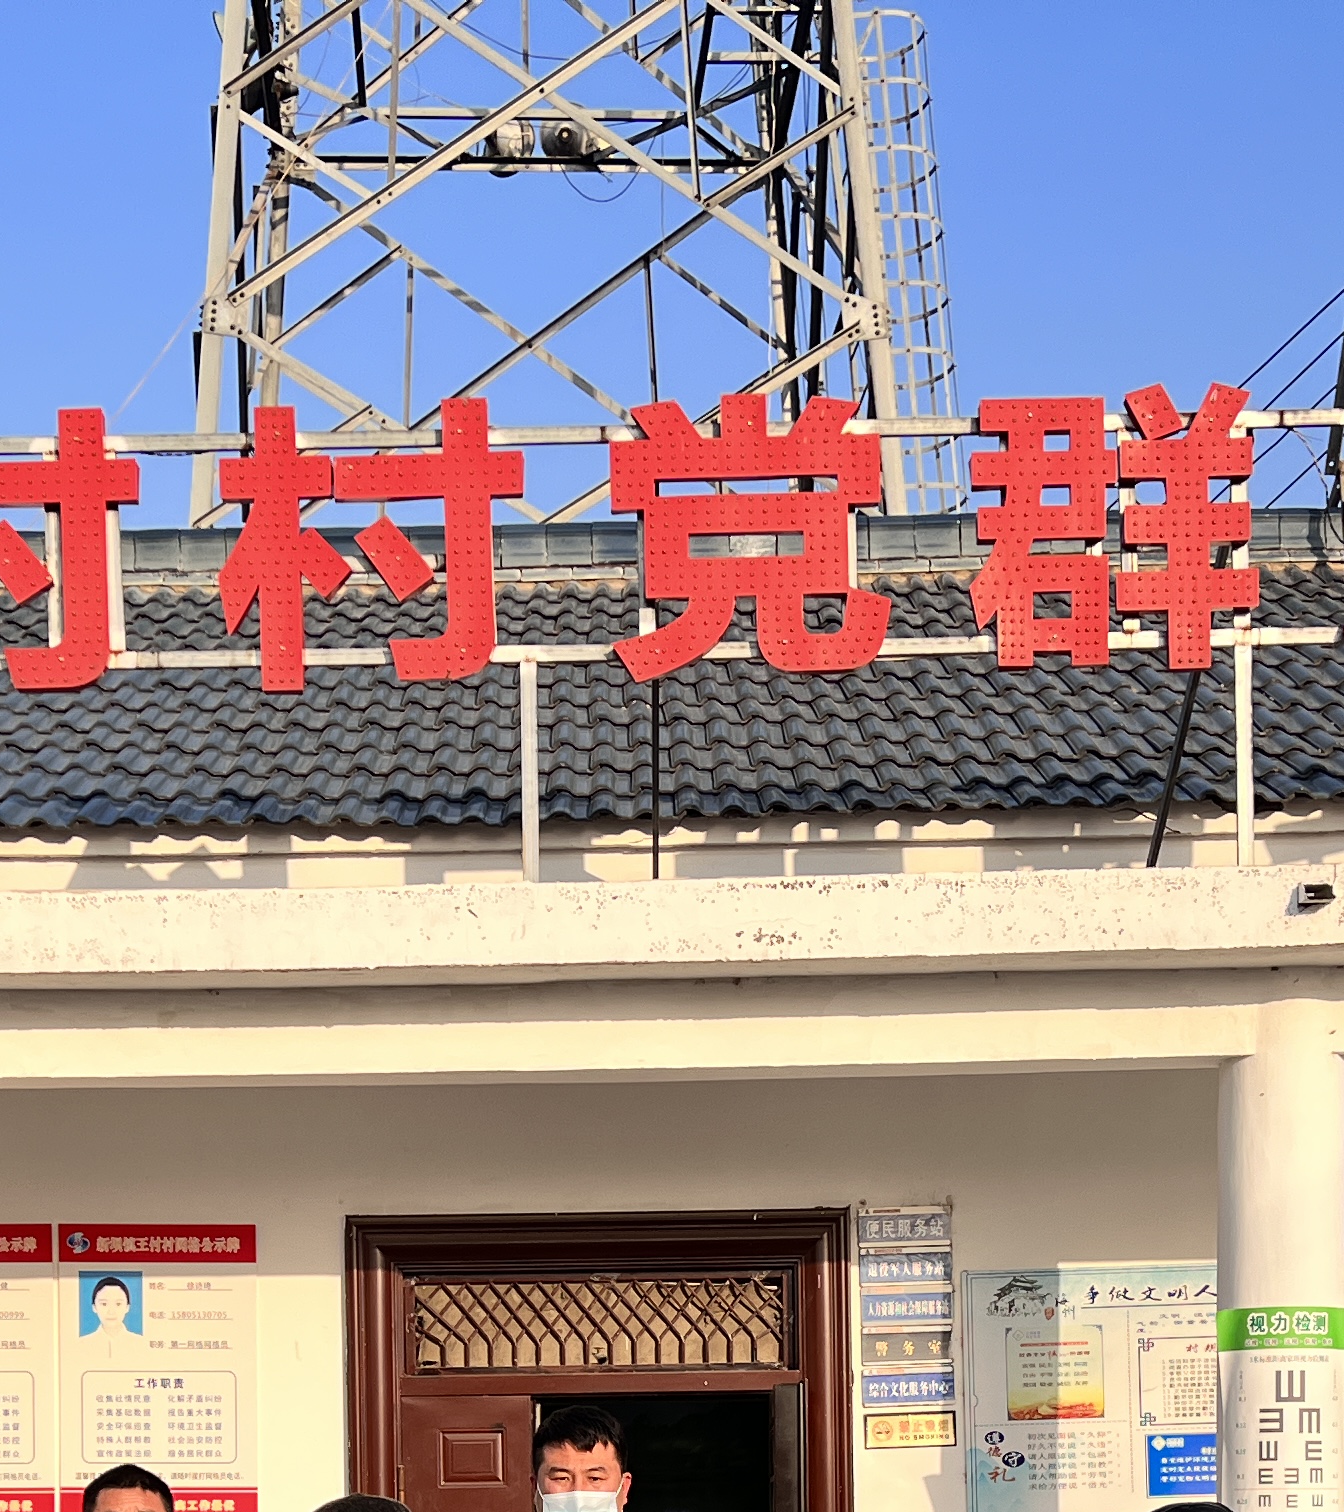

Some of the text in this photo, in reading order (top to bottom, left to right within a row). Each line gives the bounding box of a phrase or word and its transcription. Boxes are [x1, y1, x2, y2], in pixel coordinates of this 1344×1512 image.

[866, 1219, 944, 1239] 便民服务站
[868, 1261, 945, 1277] 退役军人服务站
[1249, 1314, 1326, 1332] 视力检测
[134, 1378, 184, 1389] 工作职责
[868, 1380, 949, 1398] 综合文化服务中心
